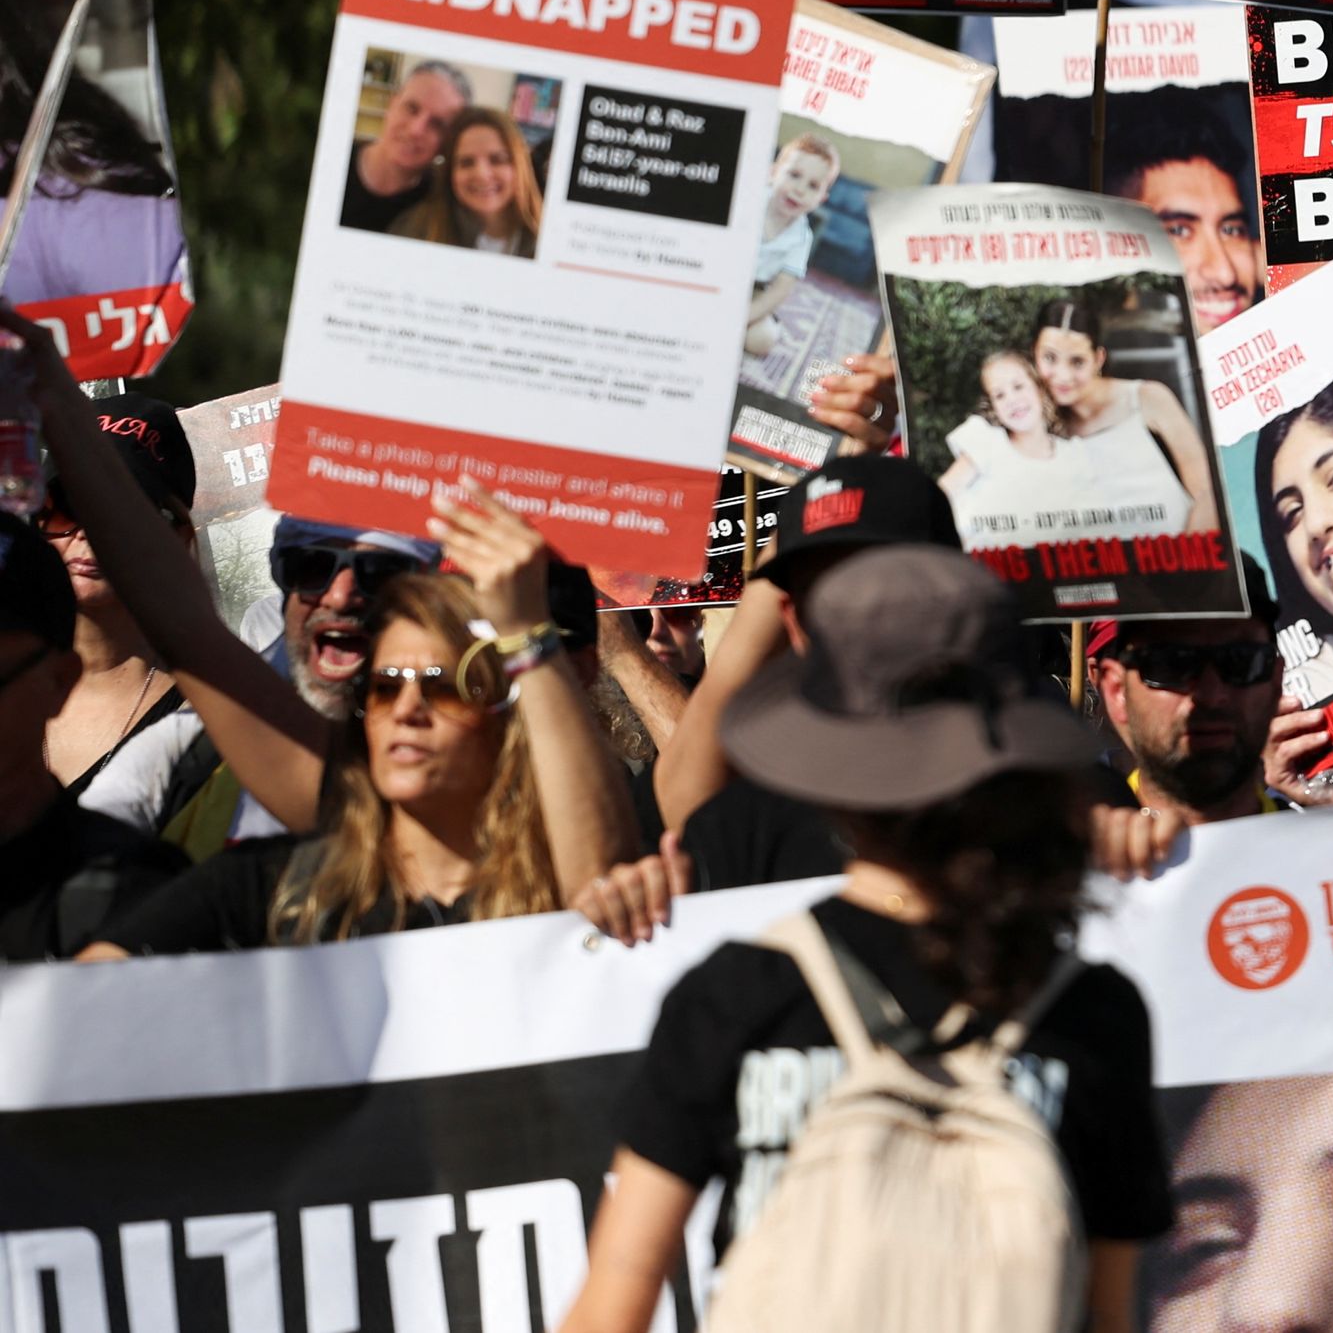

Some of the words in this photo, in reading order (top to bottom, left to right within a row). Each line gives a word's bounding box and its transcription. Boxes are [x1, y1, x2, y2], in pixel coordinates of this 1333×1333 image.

[1137, 22, 1195, 45] אביתר
[1159, 52, 1199, 78] DAVID
[801, 86, 829, 114] (4)
[824, 67, 870, 100] BIBAS
[589, 96, 645, 123] Ohad
[645, 105, 664, 127] &
[665, 108, 706, 134] Raz
[1064, 230, 1102, 261] (15)
[1218, 343, 1255, 377] זכריה
[1252, 329, 1278, 359] עדן
[1210, 377, 1245, 410] EDEN
[1242, 344, 1307, 393] ZECHARYA
[1254, 383, 1284, 417] (28)
[306, 427, 353, 454] Take
[355, 442, 371, 458] a
[374, 443, 434, 470] photo
[435, 452, 458, 473] of
[461, 455, 496, 480] this
[500, 465, 564, 490] poster
[566, 471, 608, 496] and
[610, 478, 667, 506] share
[669, 487, 685, 508] it
[308, 455, 378, 488] Please
[382, 467, 430, 497] help
[548, 496, 610, 524] home
[613, 509, 670, 536] alive.
[1035, 536, 1128, 580] THEM
[1133, 529, 1228, 573] HOME
